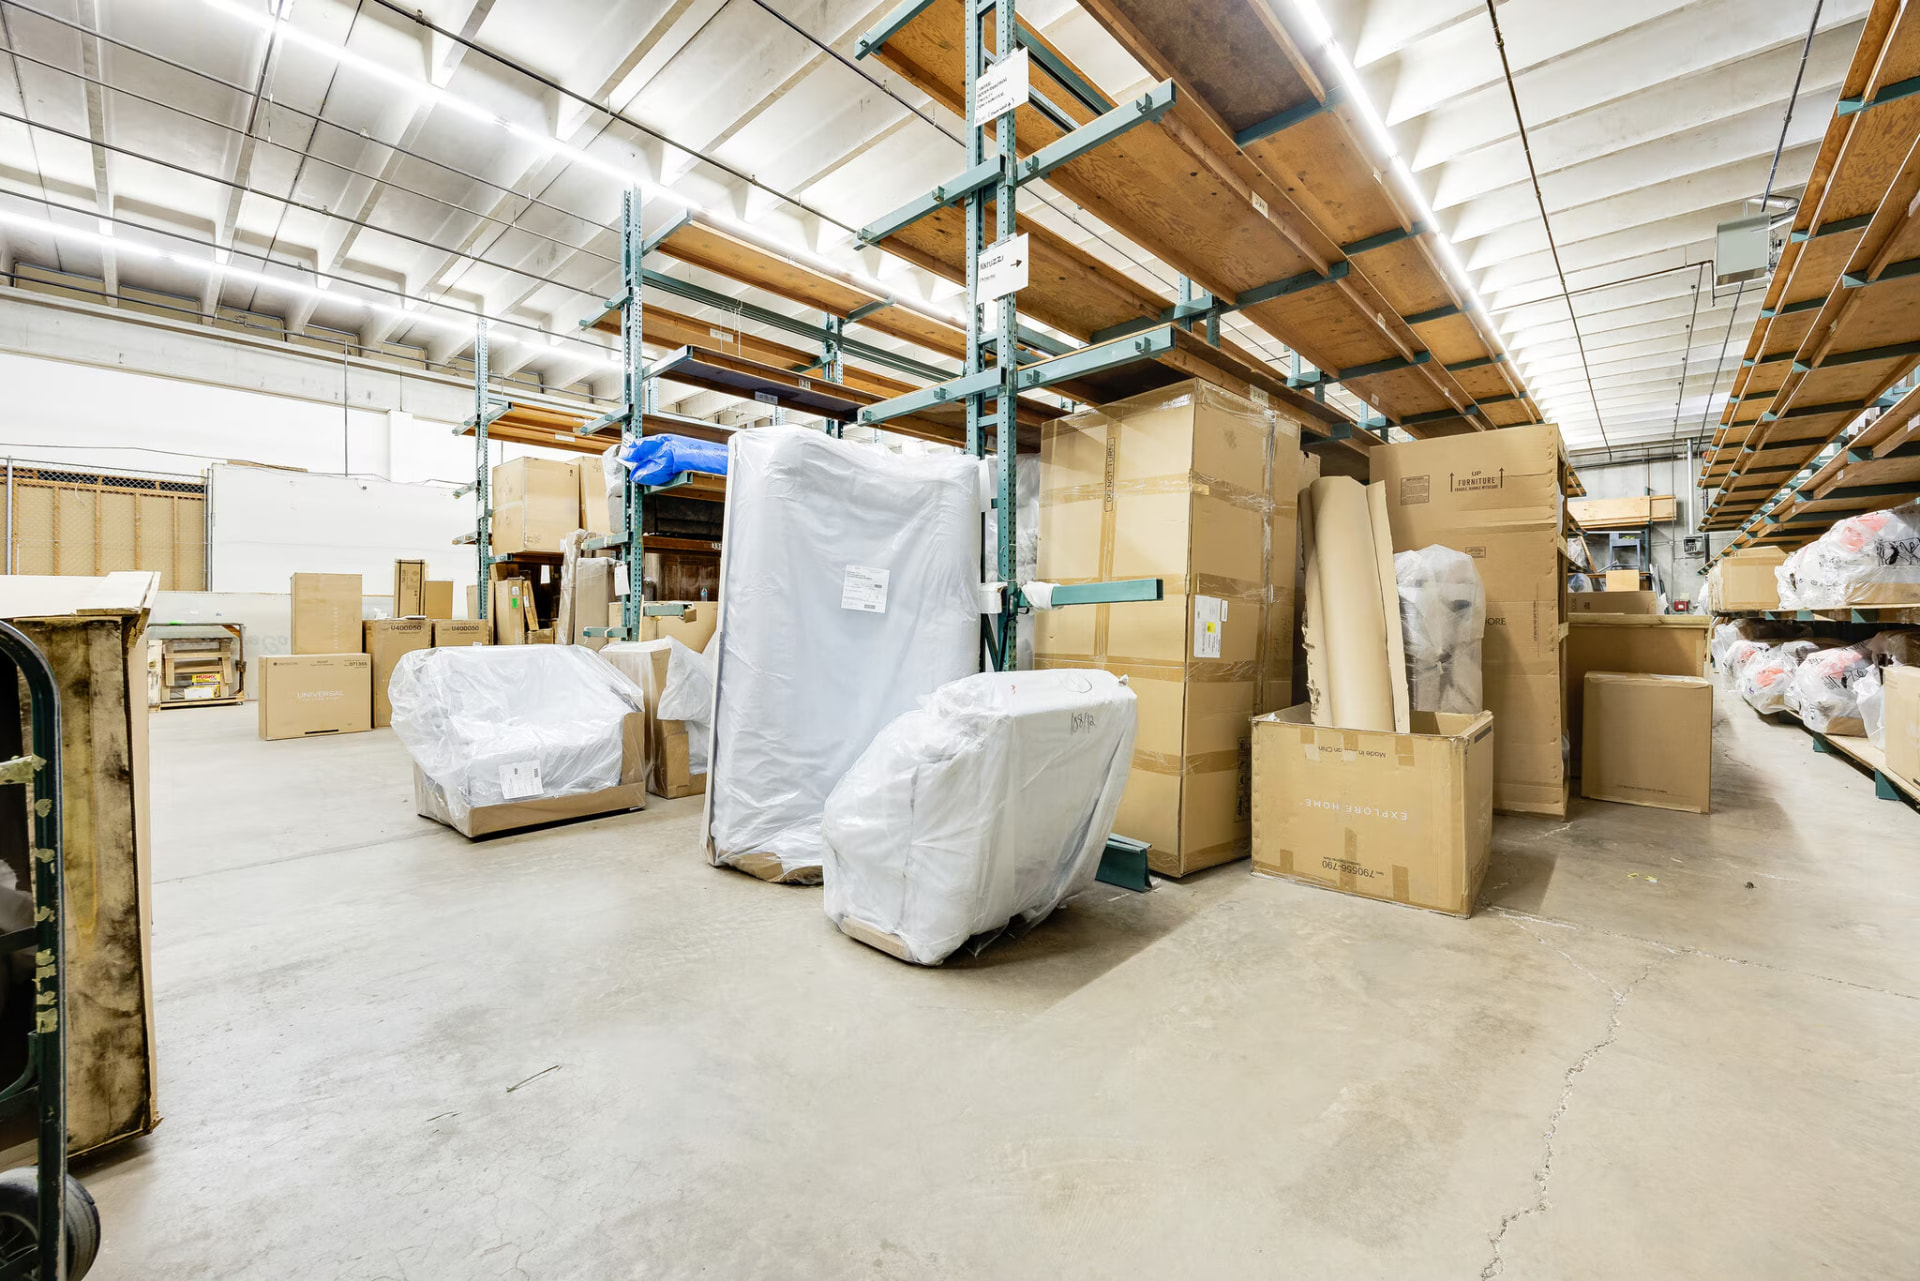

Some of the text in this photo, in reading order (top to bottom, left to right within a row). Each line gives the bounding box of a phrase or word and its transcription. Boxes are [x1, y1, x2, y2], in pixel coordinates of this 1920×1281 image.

[1458, 476, 1496, 487] FURNITURE
[1318, 745, 1333, 753] Chin
[1365, 750, 1387, 759] Made
[1305, 798, 1408, 821] EXPLORE HOME
